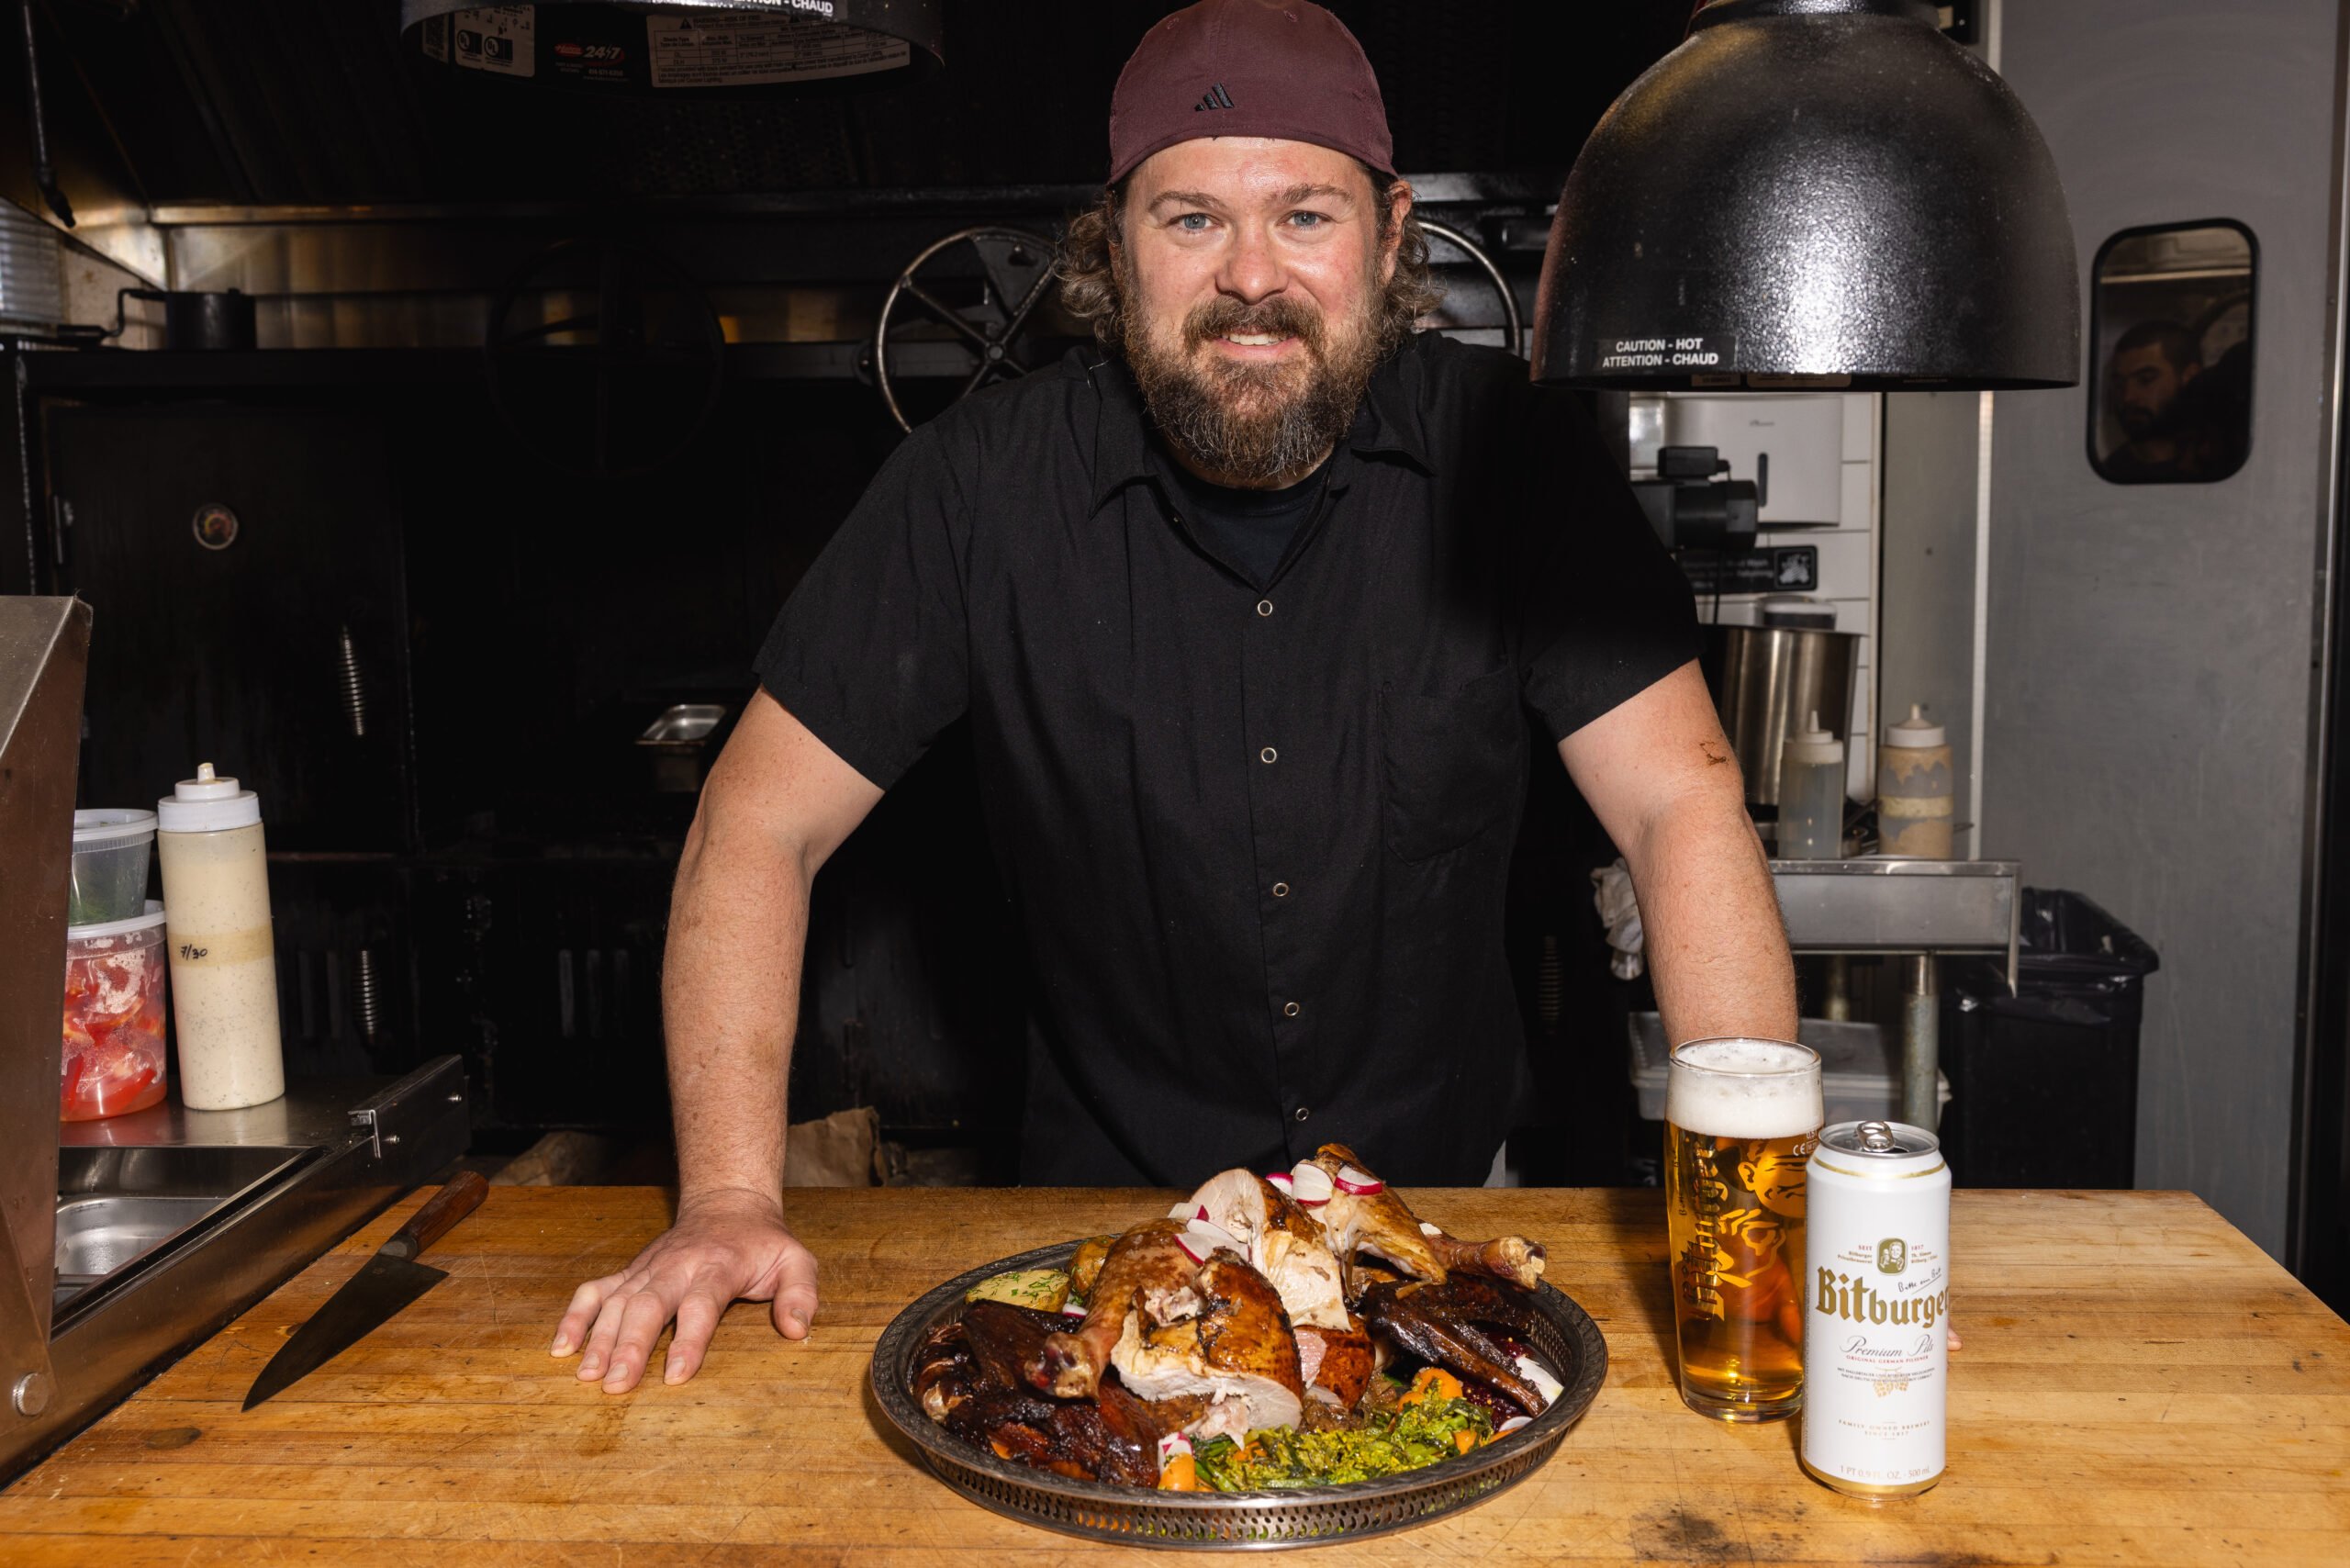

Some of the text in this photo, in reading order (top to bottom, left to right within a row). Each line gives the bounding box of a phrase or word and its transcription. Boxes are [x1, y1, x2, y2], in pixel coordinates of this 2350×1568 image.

[791, 0, 834, 14] CHAUD
[1616, 339, 1666, 353] CAUTION
[1675, 338, 1704, 351] HOT
[1602, 353, 1662, 367] ATTENTION
[1673, 353, 1719, 365] CHAUD
[180, 943, 208, 960] 7/30
[1839, 1334, 1934, 1357] Premium Pils
[1846, 1355, 1876, 1363] ORIGINAL
[1846, 1467, 1856, 1475] PT
